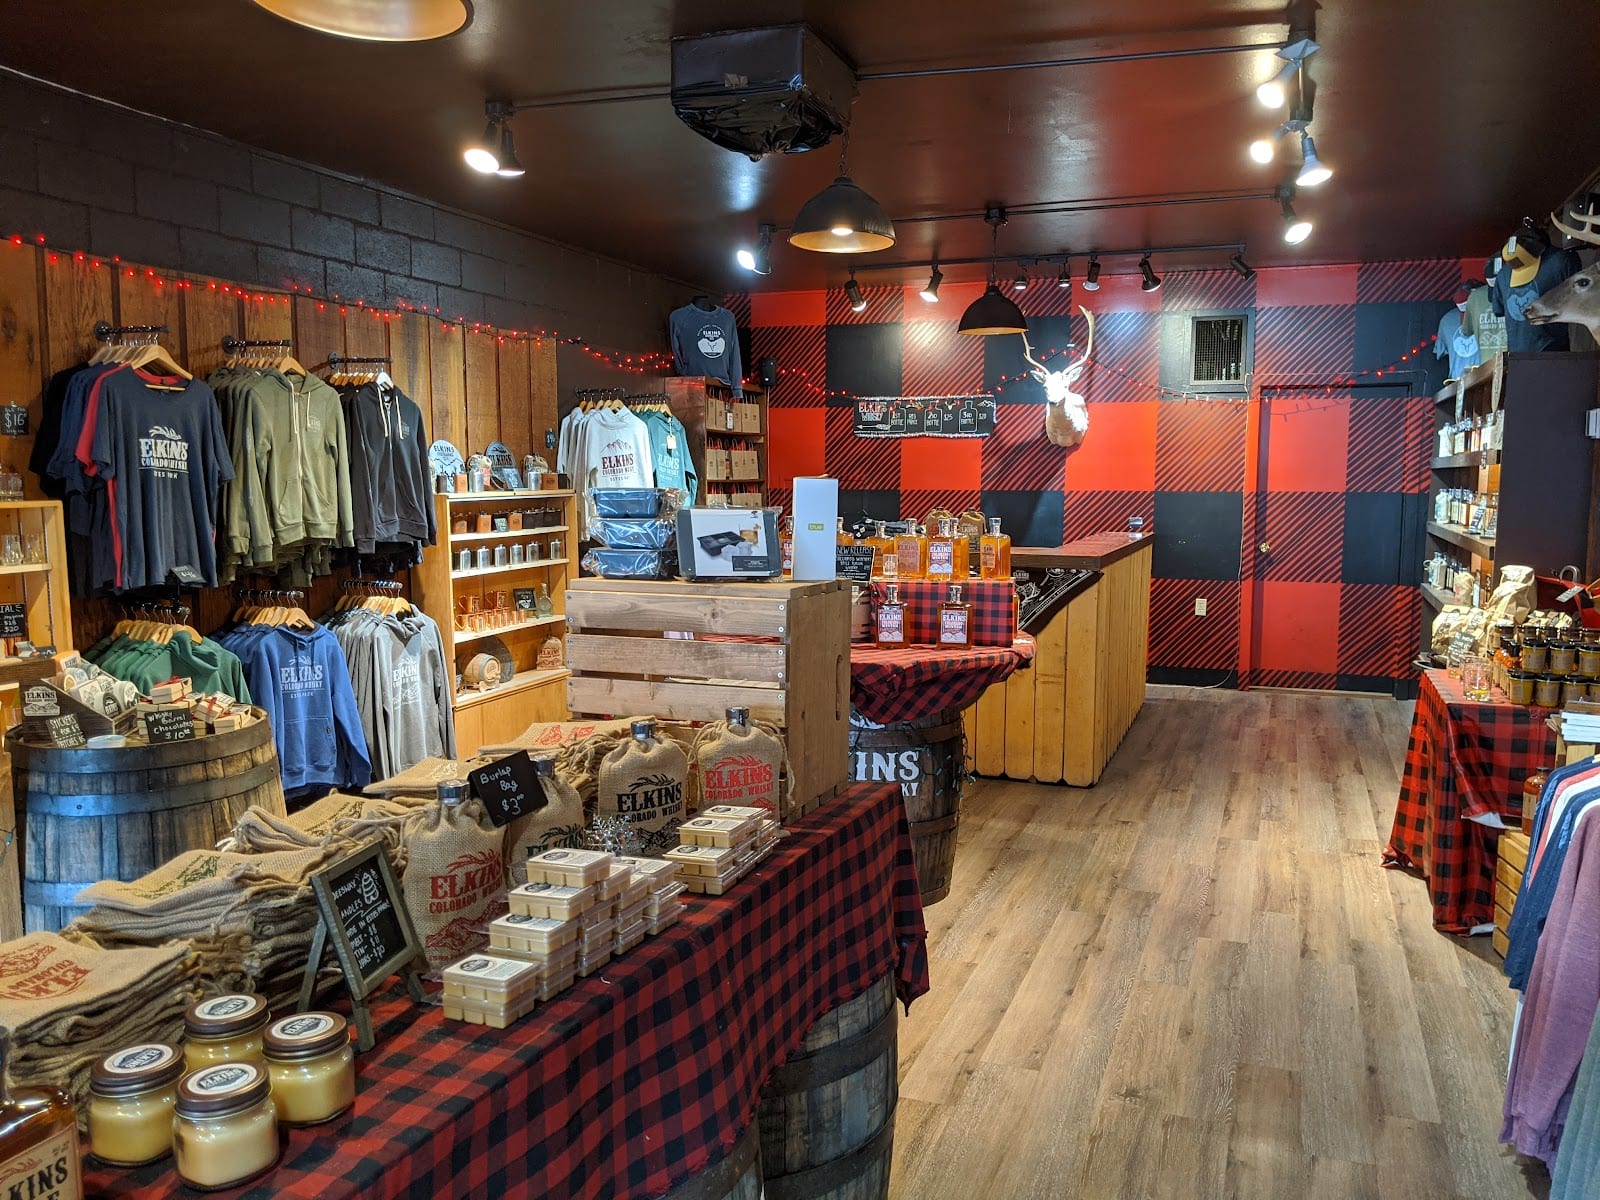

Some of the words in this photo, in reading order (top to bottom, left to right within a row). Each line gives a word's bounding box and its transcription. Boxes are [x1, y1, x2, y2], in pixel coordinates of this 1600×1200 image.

[139, 439, 188, 461] ELKINS
[433, 445, 455, 453] ELKINS
[601, 454, 634, 470] ELKINS
[280, 665, 324, 684] ELKINS
[480, 766, 511, 785] Burlap
[848, 750, 920, 781] INS
[499, 780, 519, 793] Bag
[704, 763, 774, 790] ELKINS
[616, 782, 683, 813] ELKINS
[704, 789, 743, 800] COLORADO
[615, 810, 657, 823] COORADO
[429, 855, 502, 900] ELKIN
[340, 898, 364, 919] ANDLES
[428, 894, 477, 914] COLORADO
[200, 1069, 243, 1089] ELKINS
